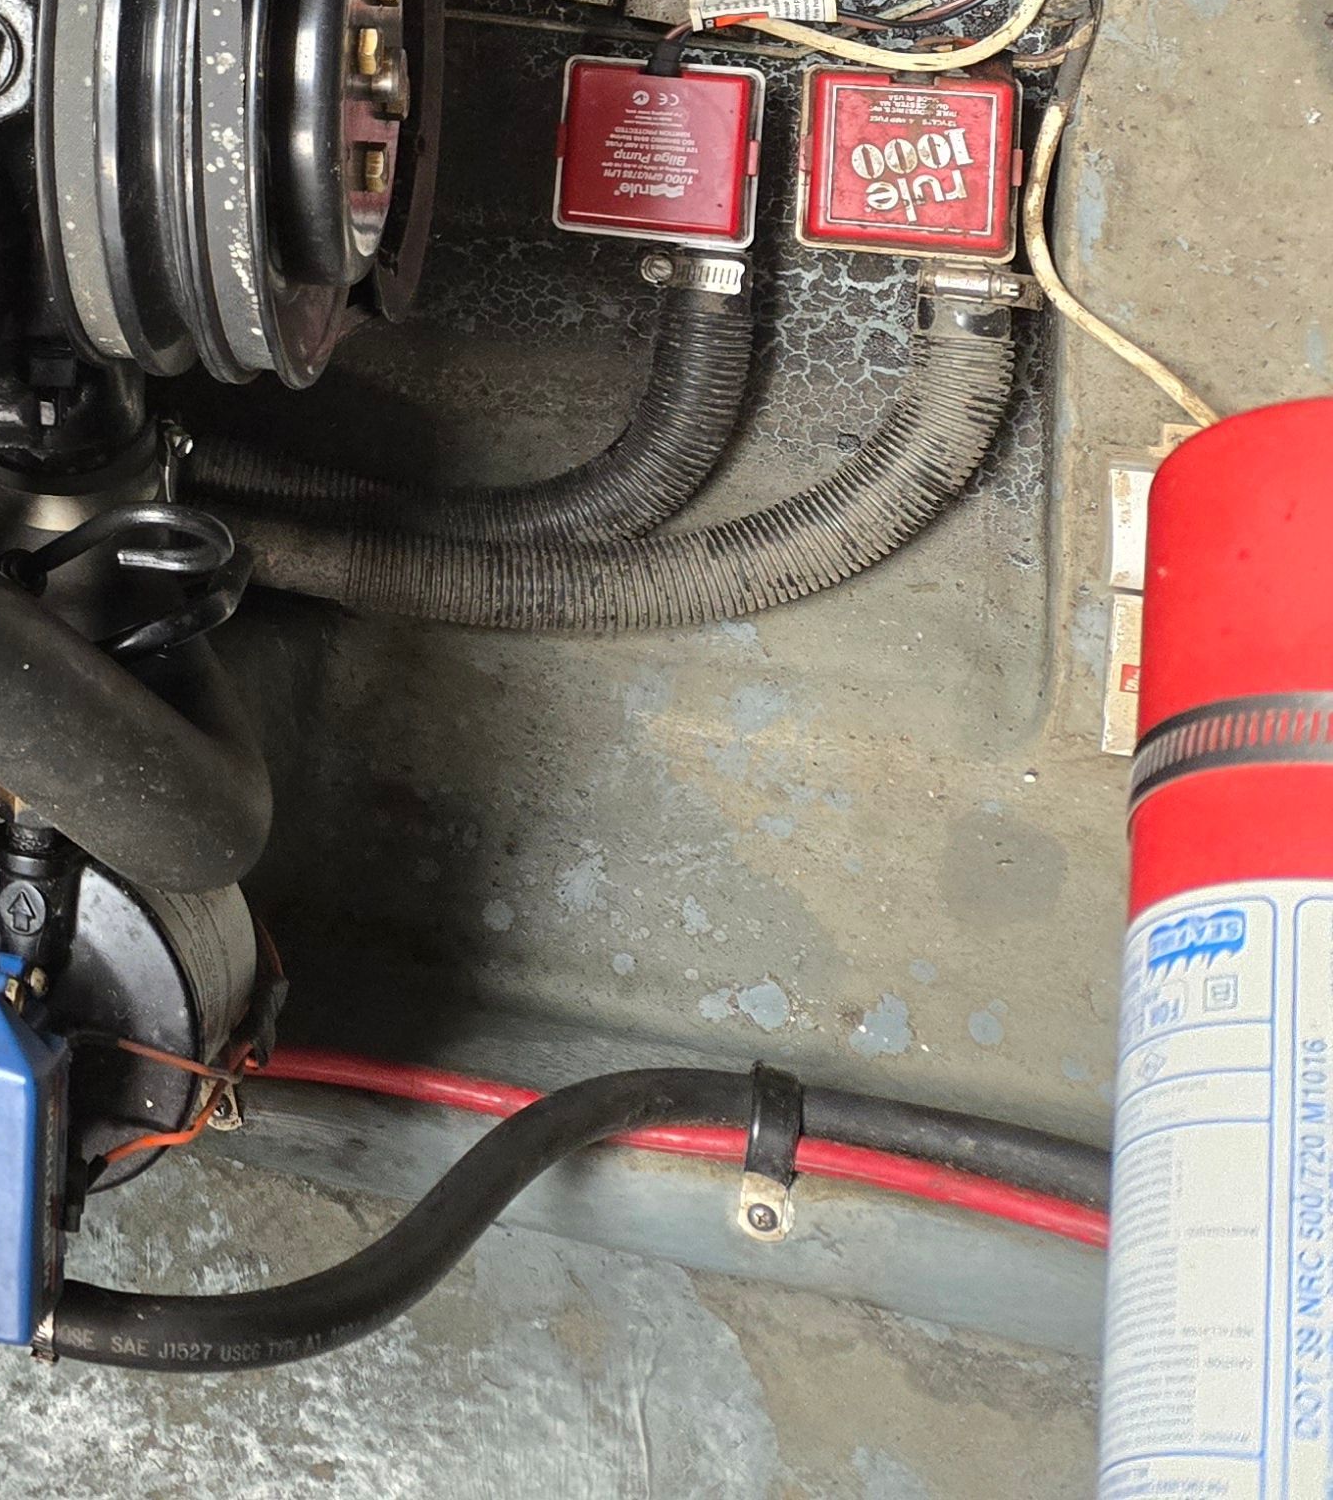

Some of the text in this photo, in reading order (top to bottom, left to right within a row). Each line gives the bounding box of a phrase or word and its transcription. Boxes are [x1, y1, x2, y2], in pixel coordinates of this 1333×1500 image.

[614, 126, 657, 136] PROTECTED
[851, 128, 974, 179] 1000
[613, 149, 687, 167] Bilge Pump
[665, 174, 694, 185] 1000
[866, 169, 967, 222] rule
[1300, 1038, 1328, 1124] M1016
[1298, 1134, 1327, 1242] 500/720
[1297, 1249, 1325, 1317] NRC
[110, 1336, 149, 1358] SAE
[158, 1343, 213, 1362] J1527
